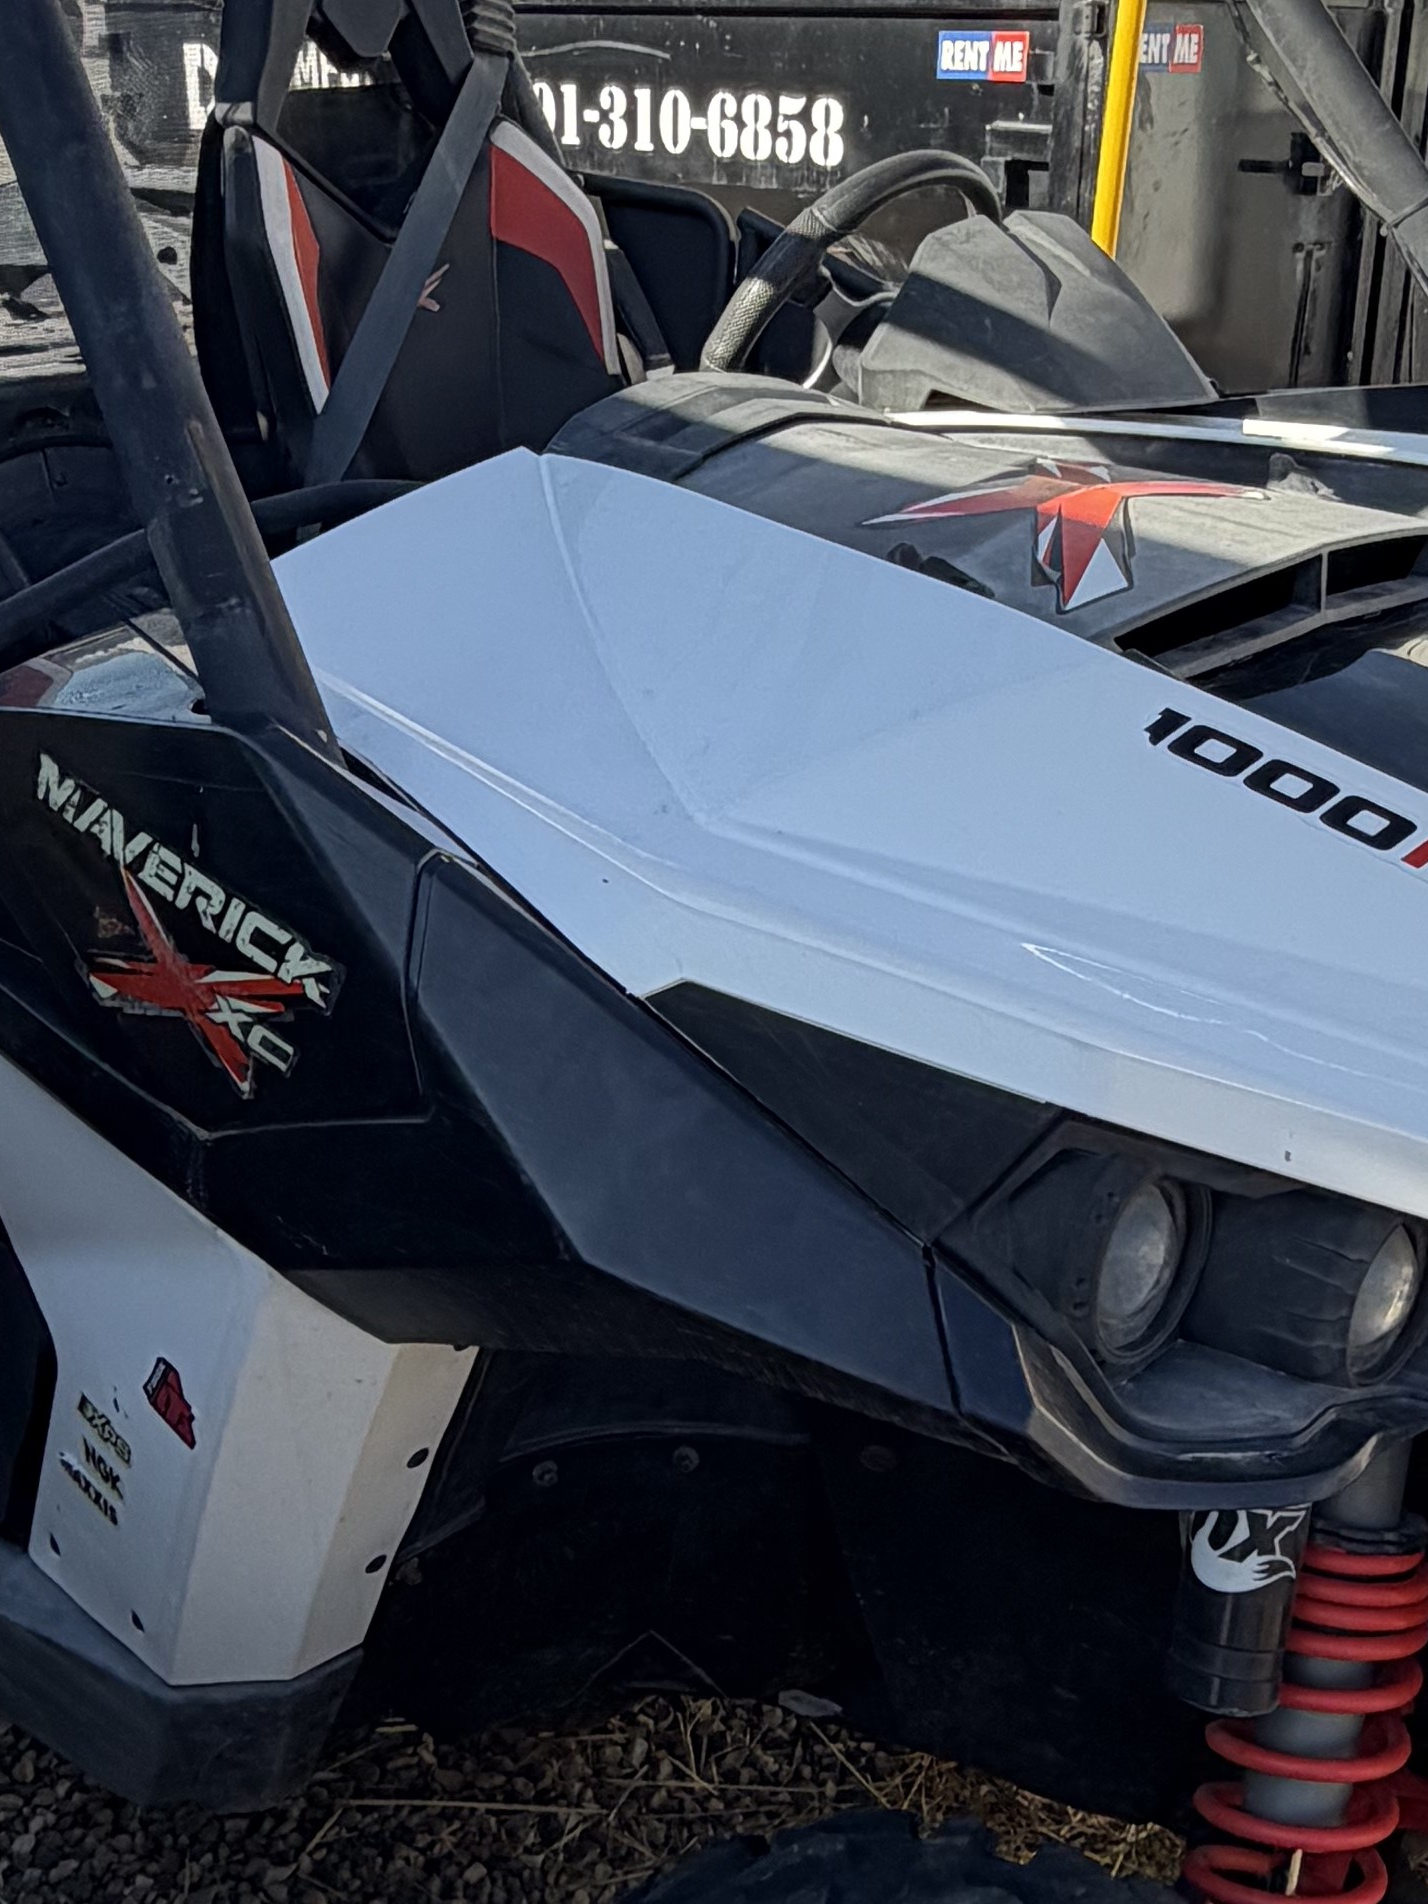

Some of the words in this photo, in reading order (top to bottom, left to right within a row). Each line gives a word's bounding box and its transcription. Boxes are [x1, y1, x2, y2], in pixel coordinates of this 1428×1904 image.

[940, 39, 990, 73] RENT
[993, 40, 1025, 74] ME
[1139, 33, 1171, 64] ENT
[1173, 33, 1200, 64] ME
[35, 750, 334, 1010] MAVERICK
